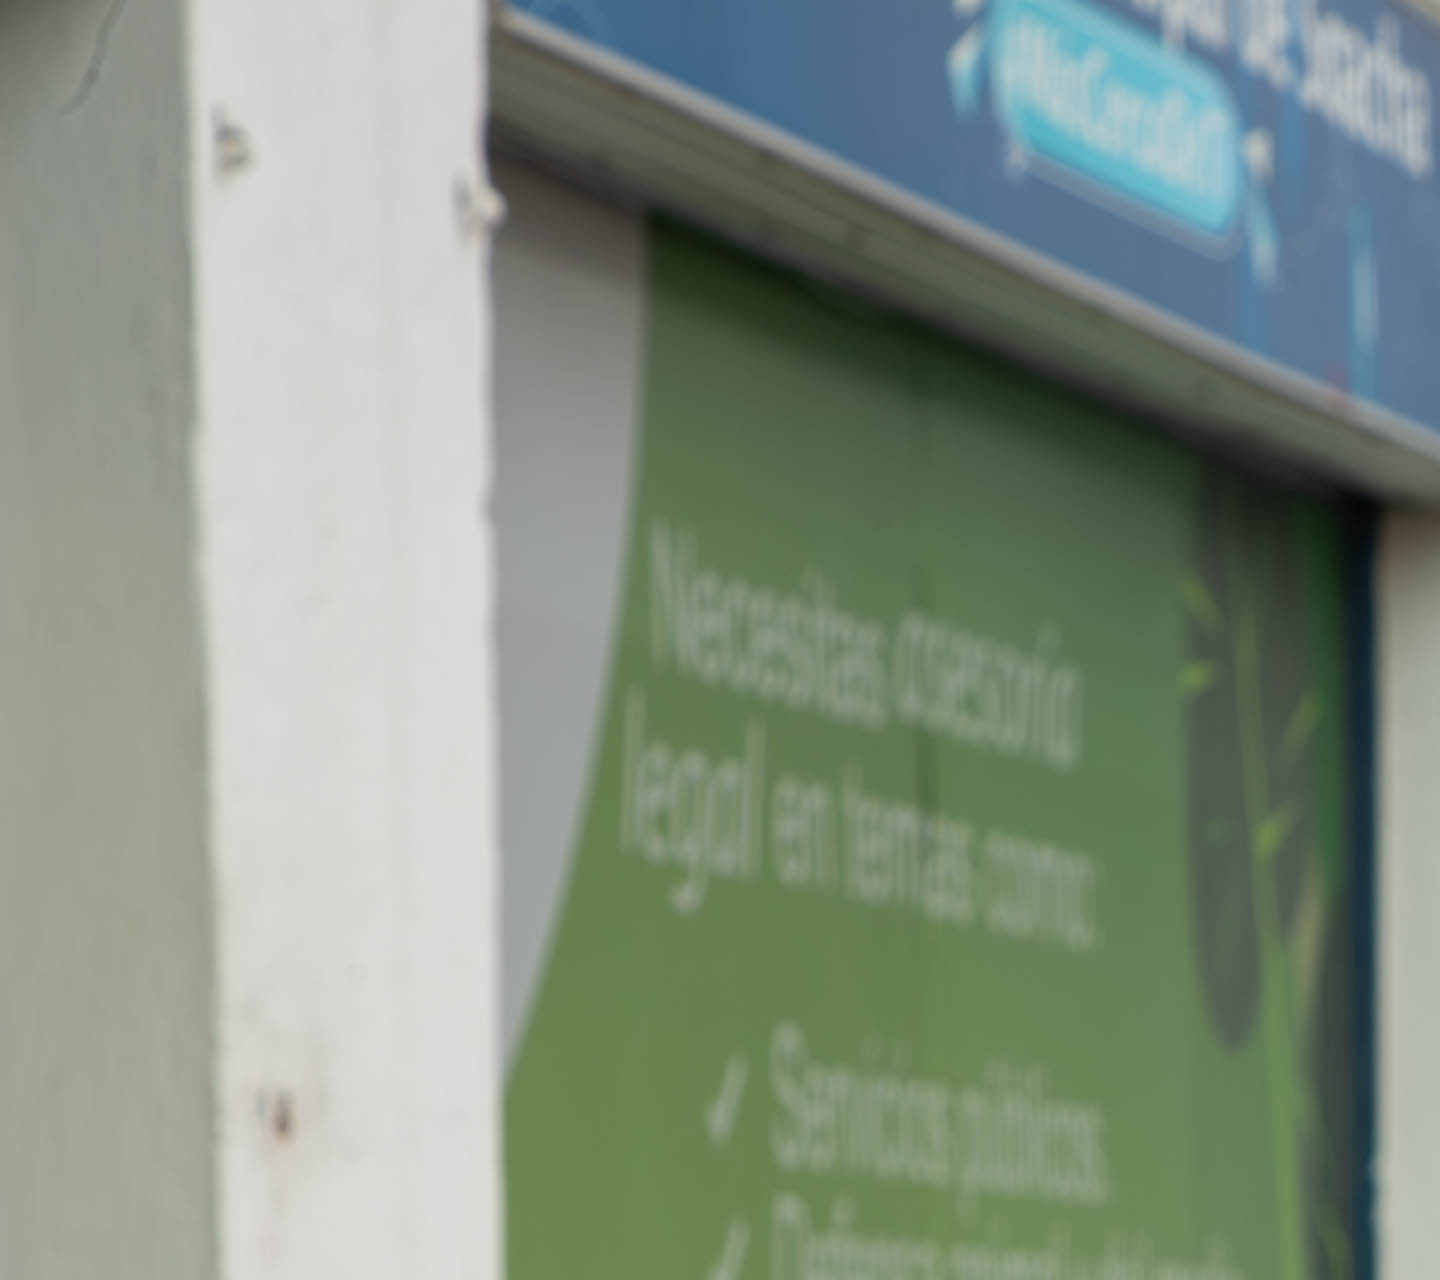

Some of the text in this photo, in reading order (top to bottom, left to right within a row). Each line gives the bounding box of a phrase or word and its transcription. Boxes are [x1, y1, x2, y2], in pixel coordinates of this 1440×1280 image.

[649, 512, 1085, 770] Necesitas asesoría
[621, 686, 766, 914] legal
[773, 778, 833, 888] en
[840, 766, 974, 924] temas
[771, 1019, 952, 1188] Servicios
